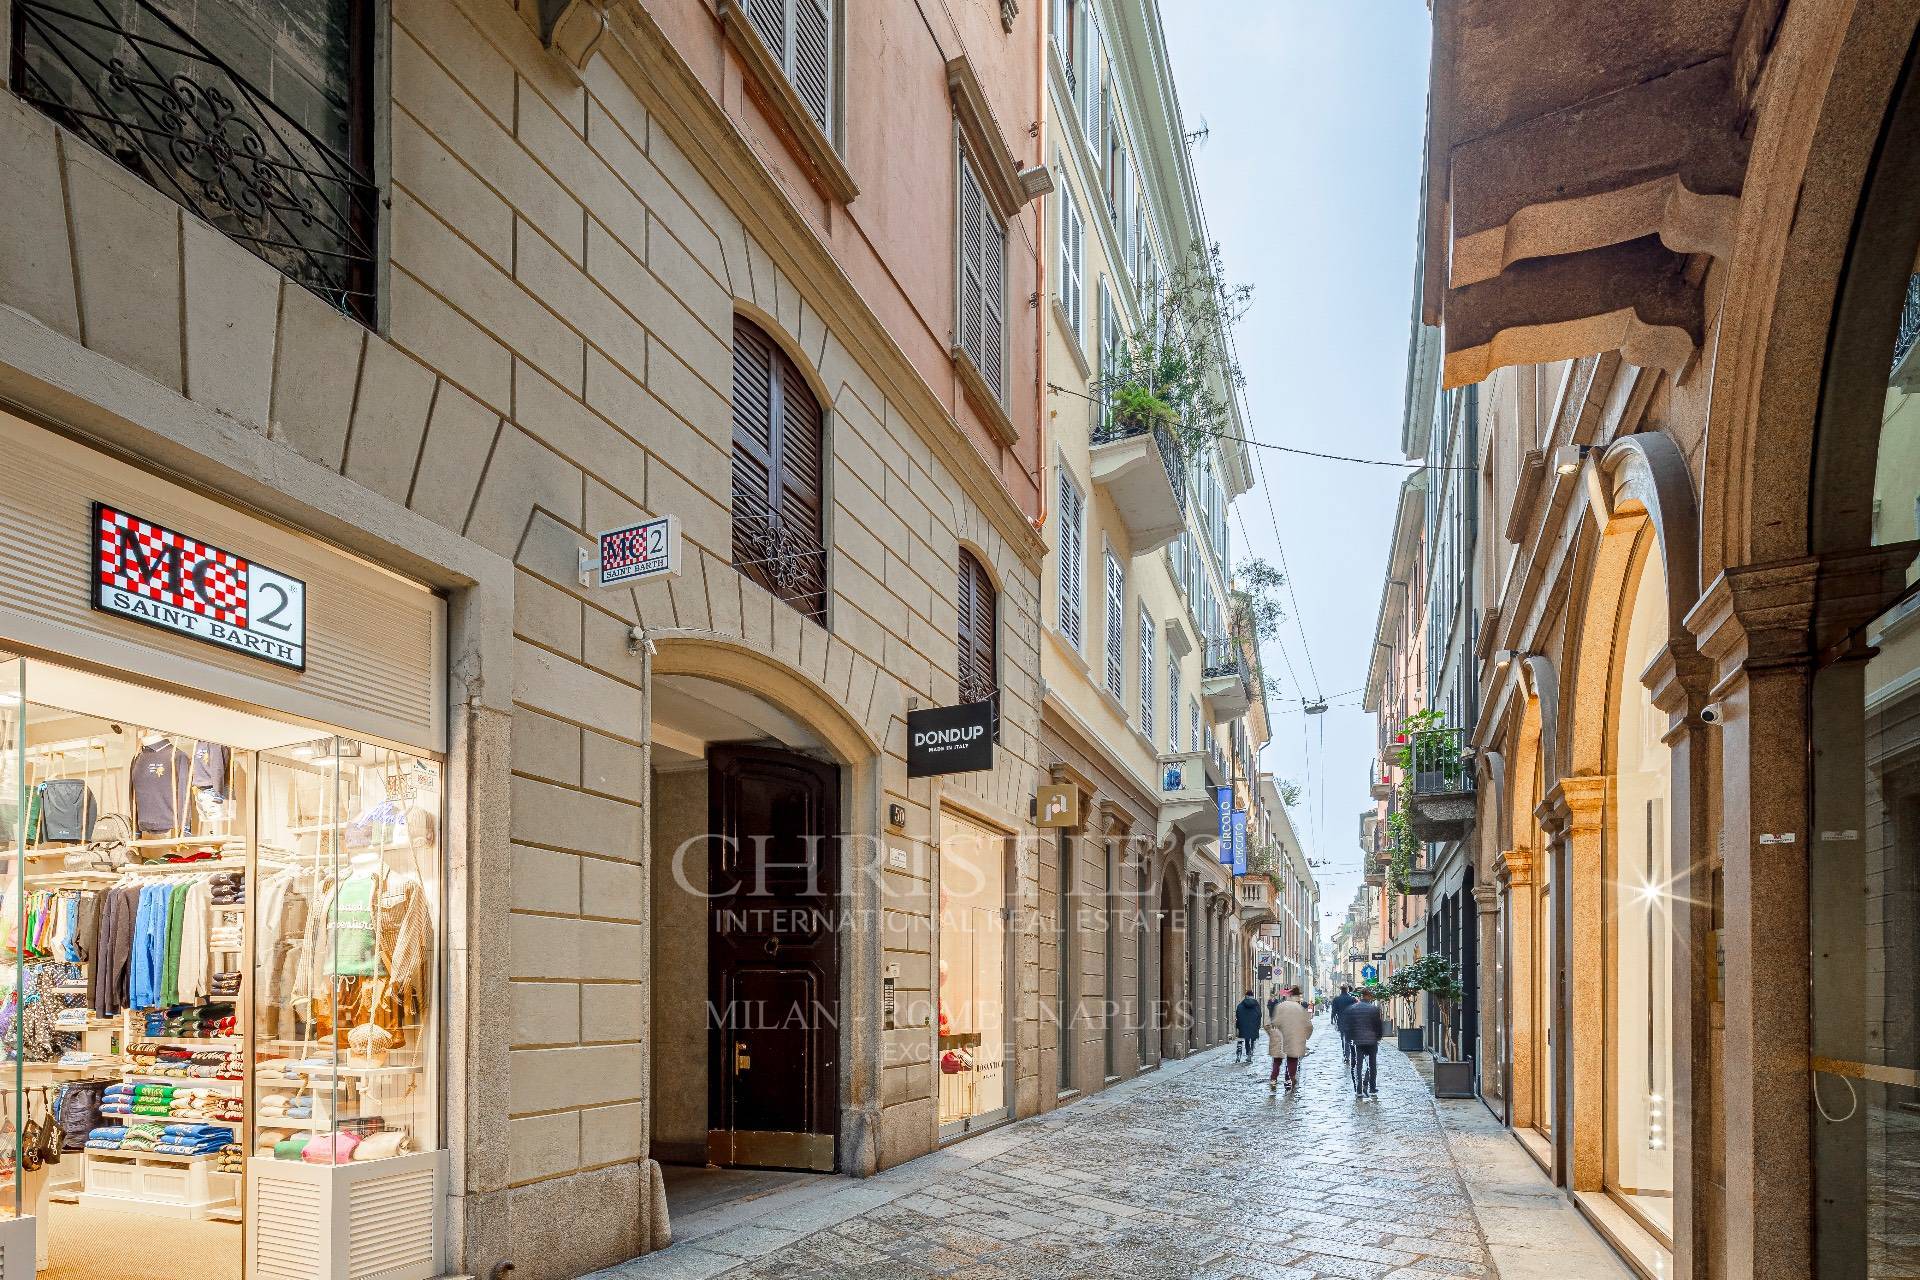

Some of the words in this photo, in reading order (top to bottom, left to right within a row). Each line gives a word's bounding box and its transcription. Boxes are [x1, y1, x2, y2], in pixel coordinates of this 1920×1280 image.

[606, 567, 632, 579] SAINT
[634, 559, 664, 572] BARTH
[113, 592, 199, 630] SAINT
[209, 621, 294, 661] BARTH
[914, 725, 984, 747] DONDUP
[1221, 801, 1232, 850] CIRCOLO
